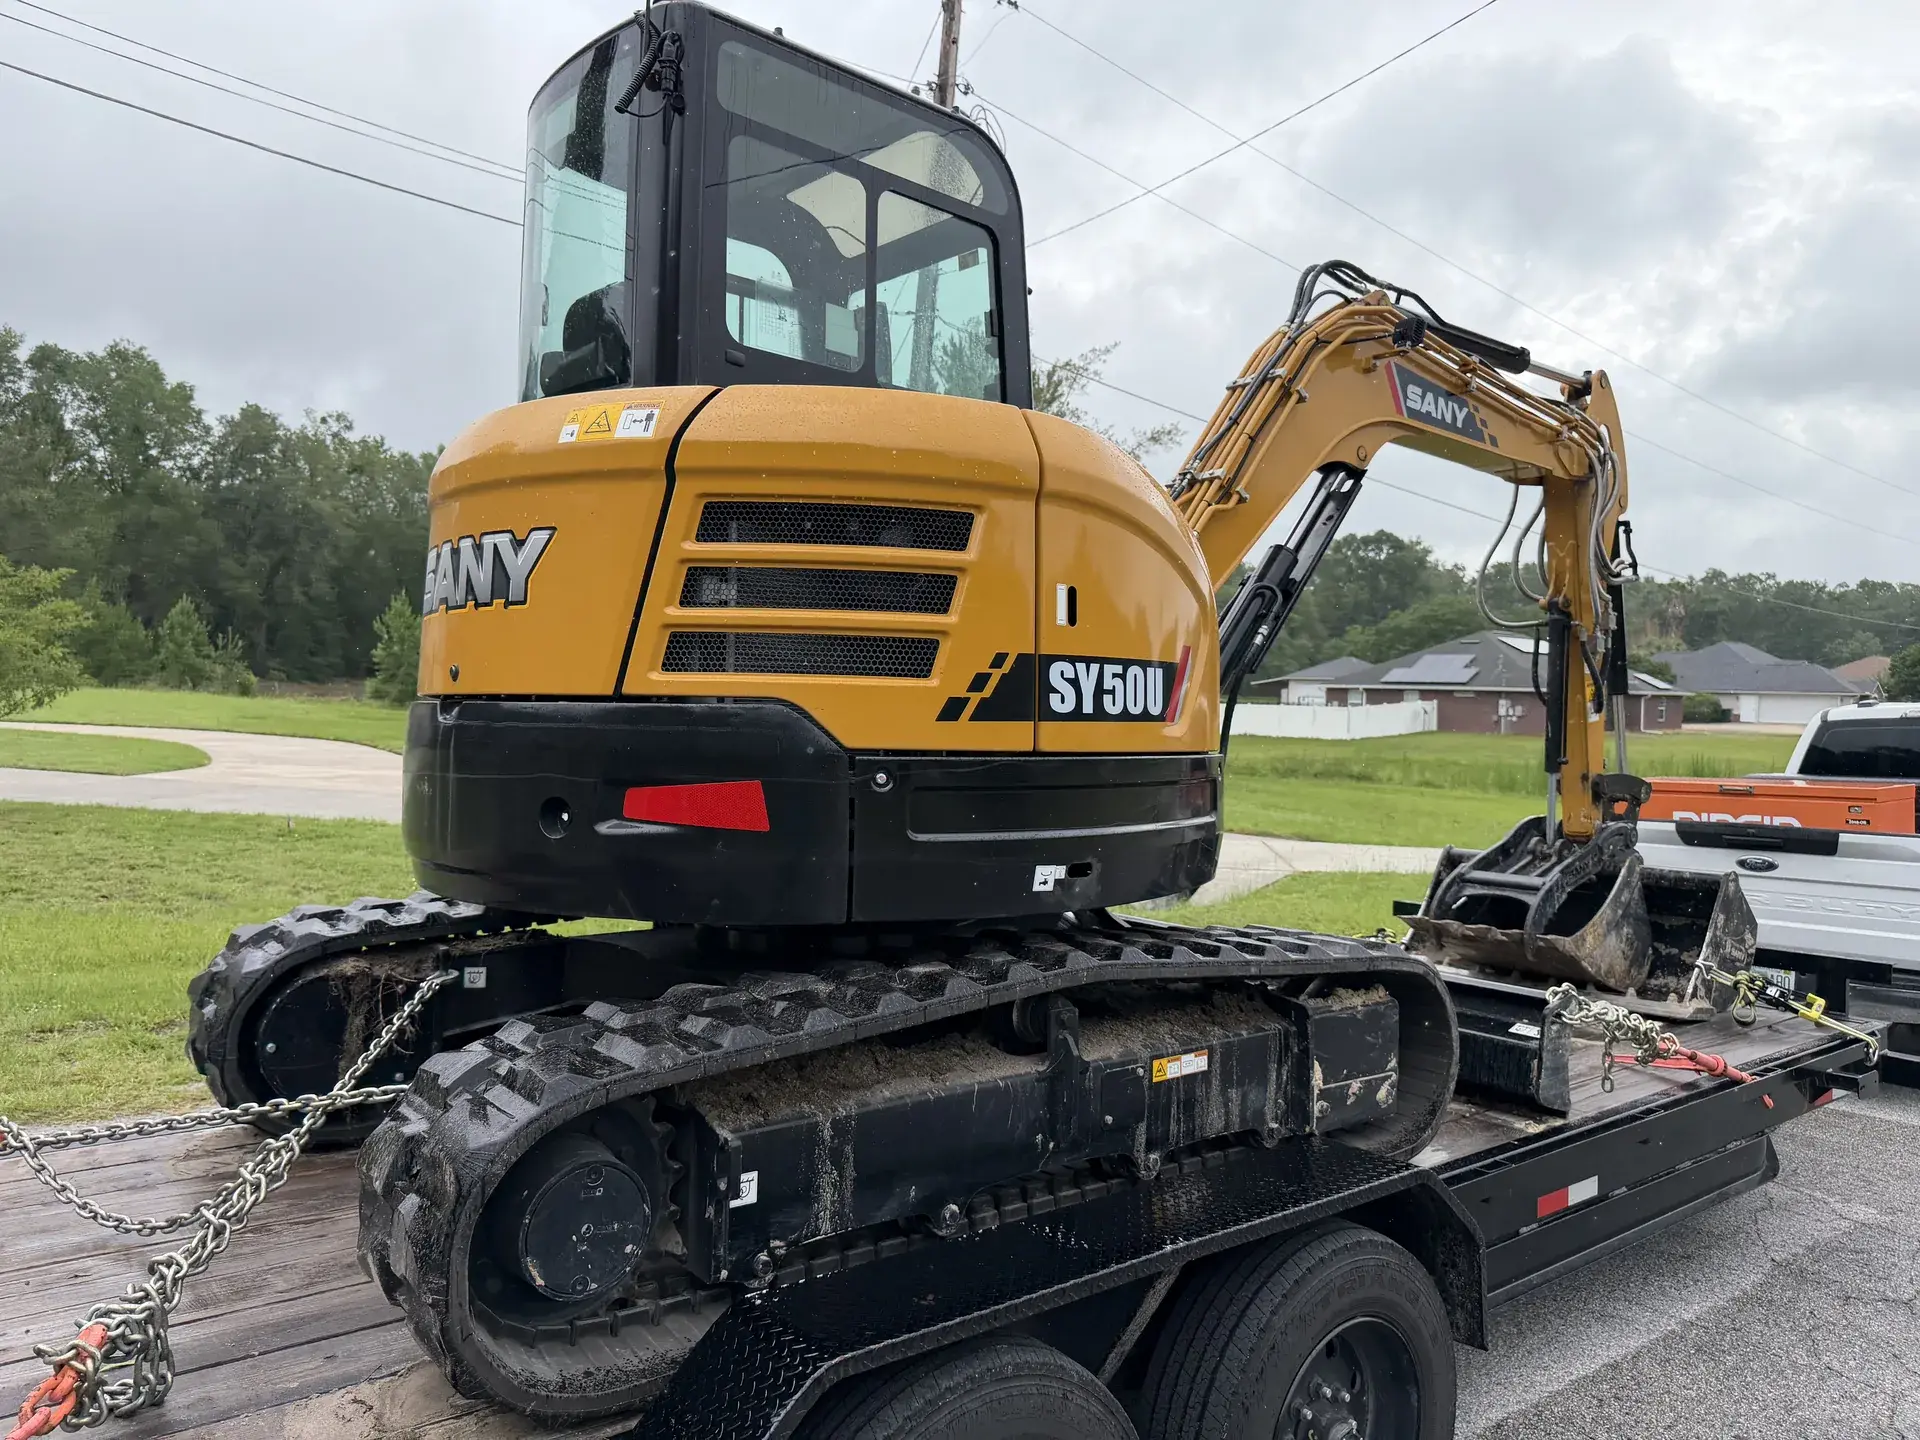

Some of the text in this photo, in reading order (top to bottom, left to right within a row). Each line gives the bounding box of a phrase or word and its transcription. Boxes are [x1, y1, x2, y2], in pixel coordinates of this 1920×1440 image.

[1406, 384, 1469, 428] SANY
[423, 528, 557, 617] SANY
[1049, 661, 1164, 716] SY50U
[1784, 896, 1920, 919] DUTY
